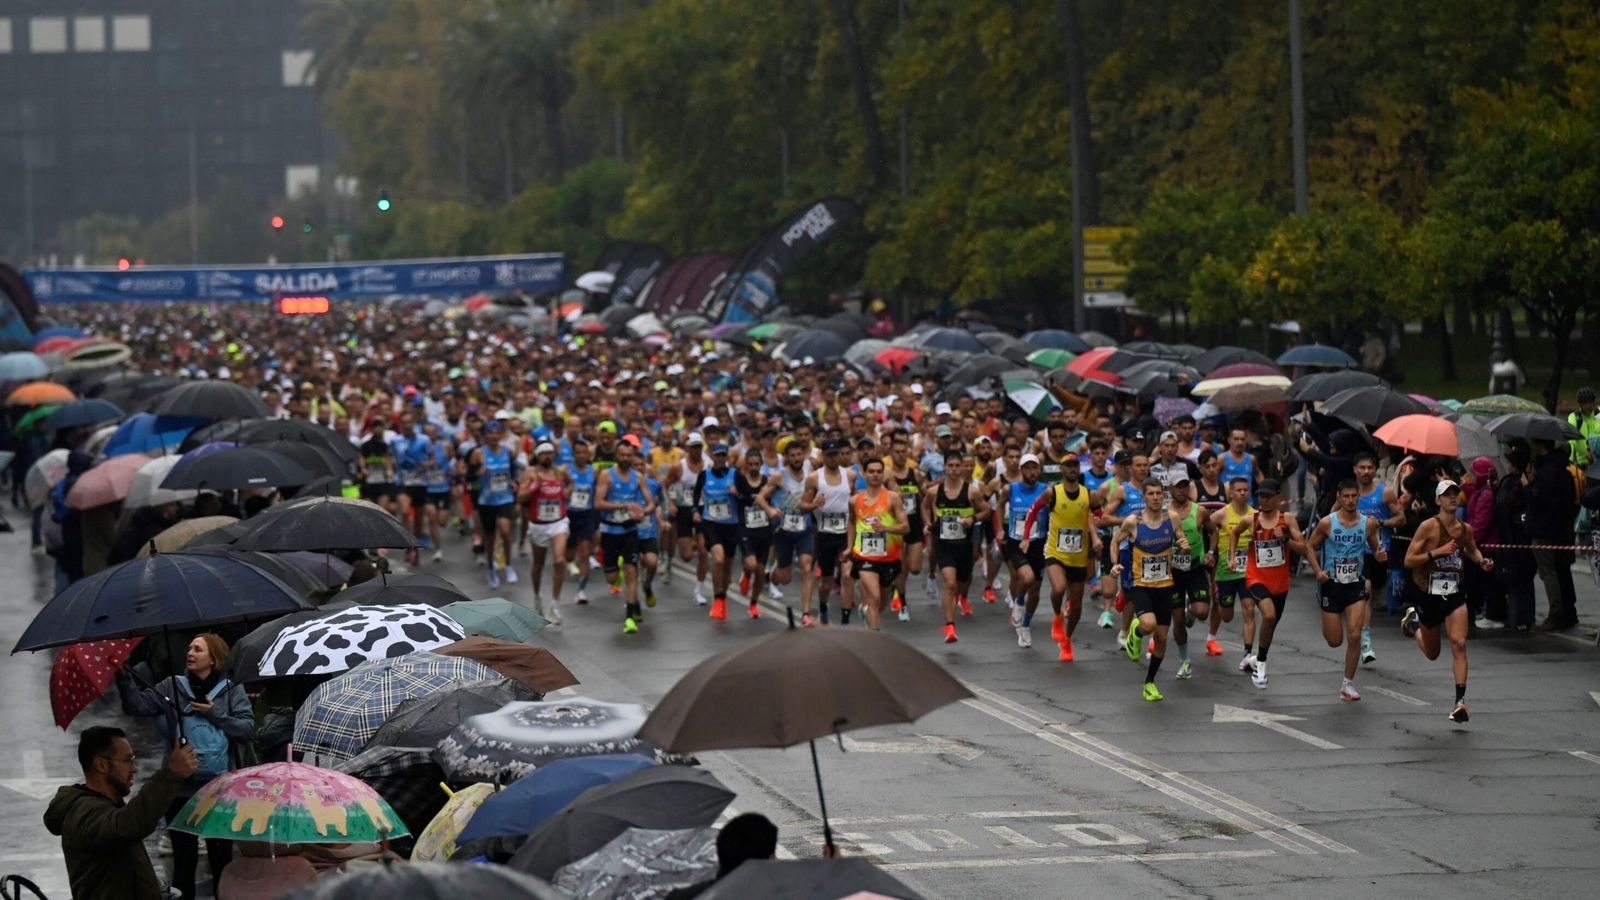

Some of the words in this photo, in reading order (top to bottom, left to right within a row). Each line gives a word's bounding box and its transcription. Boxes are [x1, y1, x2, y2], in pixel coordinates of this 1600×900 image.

[255, 272, 339, 294] SALIDA
[947, 523, 959, 532] 40
[867, 540, 878, 548] 41
[1065, 536, 1076, 545] 61
[1334, 533, 1362, 545] nerja
[1266, 548, 1273, 558] 3
[1236, 557, 1247, 567] 37
[1150, 563, 1161, 573] 44
[1336, 564, 1358, 574] 7664
[1442, 581, 1449, 591] 4
